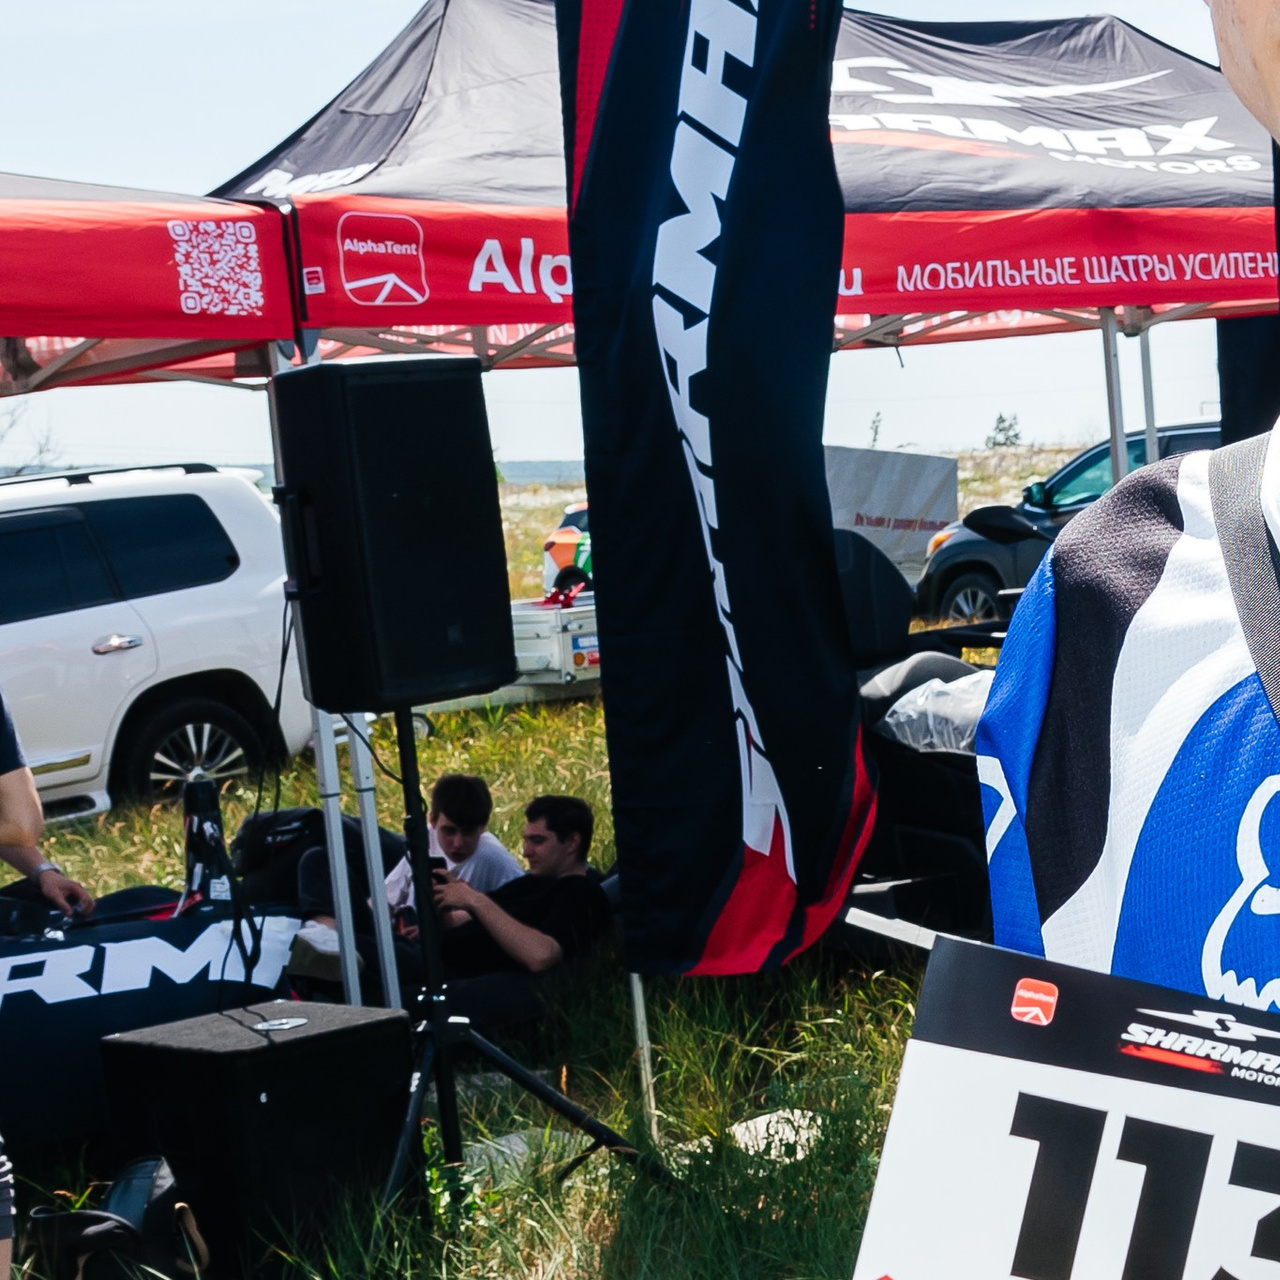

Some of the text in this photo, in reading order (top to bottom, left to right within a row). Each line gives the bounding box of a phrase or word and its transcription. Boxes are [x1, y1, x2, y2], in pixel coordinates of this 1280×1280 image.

[1048, 150, 1262, 175] MOTORS
[343, 238, 418, 256] AlphaTent
[895, 256, 1082, 292] МОБИЛЬНЫЕ
[1084, 253, 1174, 284] ШАТРЫ
